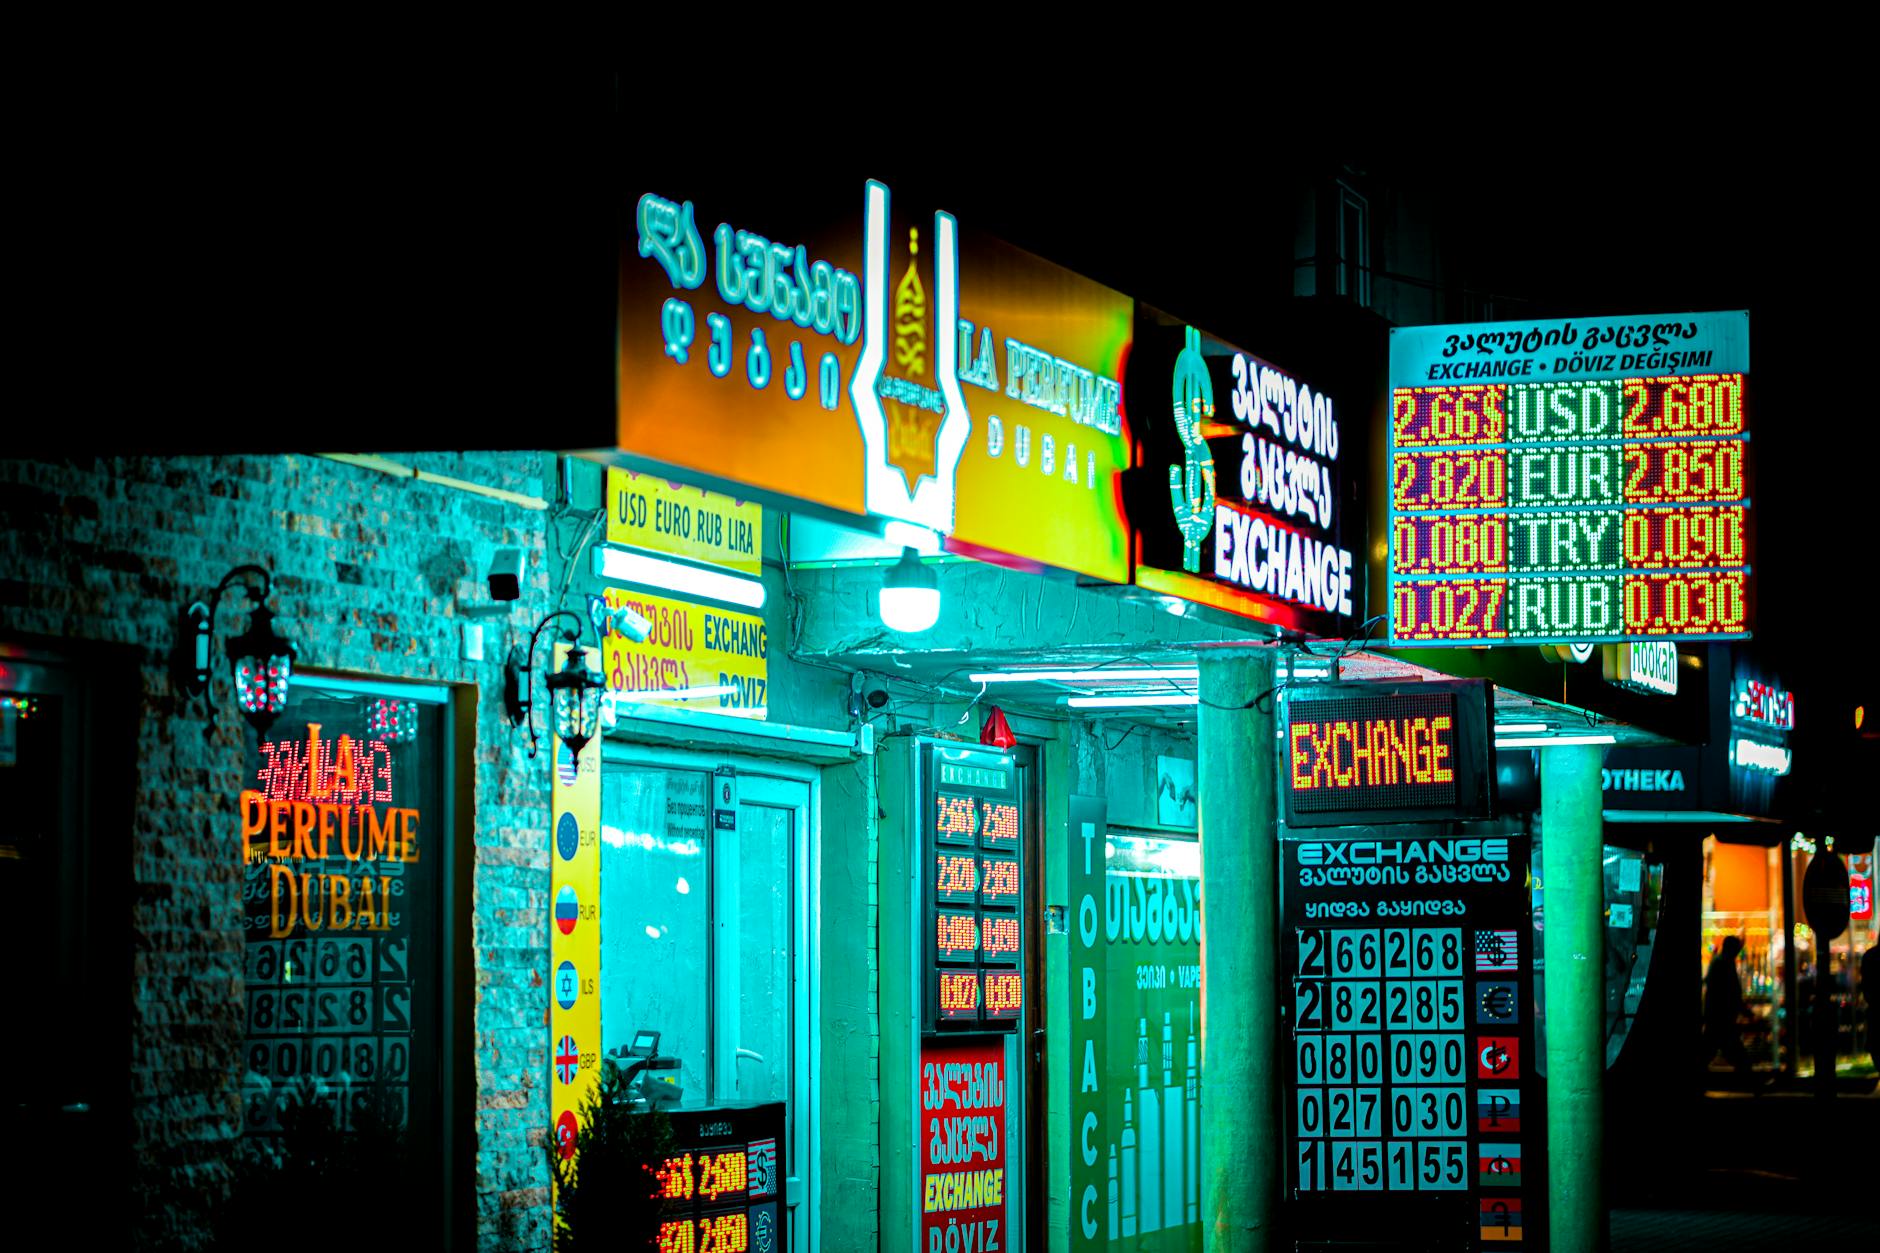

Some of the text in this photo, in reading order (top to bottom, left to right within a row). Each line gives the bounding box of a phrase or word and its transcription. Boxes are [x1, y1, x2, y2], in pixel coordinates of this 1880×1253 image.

[661, 297, 840, 410] დუბაი
[1427, 359, 1534, 380] EXCHANGE
[1553, 351, 1616, 373] DÖVIZ
[1442, 321, 1698, 358] ვალუტის გაცვლა
[958, 319, 999, 392] LA
[1004, 337, 1121, 437] PERFUME
[1232, 353, 1339, 461] ვალუტის
[1519, 387, 1609, 437] USD
[1625, 381, 1741, 432] 2.680
[987, 414, 1095, 489] DUBAI
[1394, 447, 1741, 505] 2.820 EUR 2.850
[1240, 432, 1331, 529] გაცვლა
[619, 490, 754, 555] USD EURO RUB LIRA
[1394, 513, 1741, 570] 0.080 TRY 0.090
[1215, 504, 1353, 616] EXCHANGE
[1394, 579, 1741, 633] 0.027 RUB 0.030
[307, 722, 357, 798] LA
[941, 765, 1006, 788] EXCHANGE
[1291, 716, 1453, 789] EXCHANGE
[240, 789, 420, 865] PERFUME
[580, 830, 596, 846] EUR
[1297, 839, 1508, 865] EXCHANGE
[270, 863, 392, 939] DUBAI
[1299, 863, 1510, 886] ვალუტის გაცვლა
[579, 904, 596, 920] RUR
[1305, 900, 1466, 918] ყიდვა გაყიდვა
[582, 979, 594, 995] ILS
[579, 1053, 597, 1069] GBP
[924, 1062, 1003, 1110] ვალუტის
[930, 1116, 998, 1164] გაცვლა
[924, 1168, 1003, 1213] EXCHANGE
[929, 1218, 999, 1253] DÖVIZ
